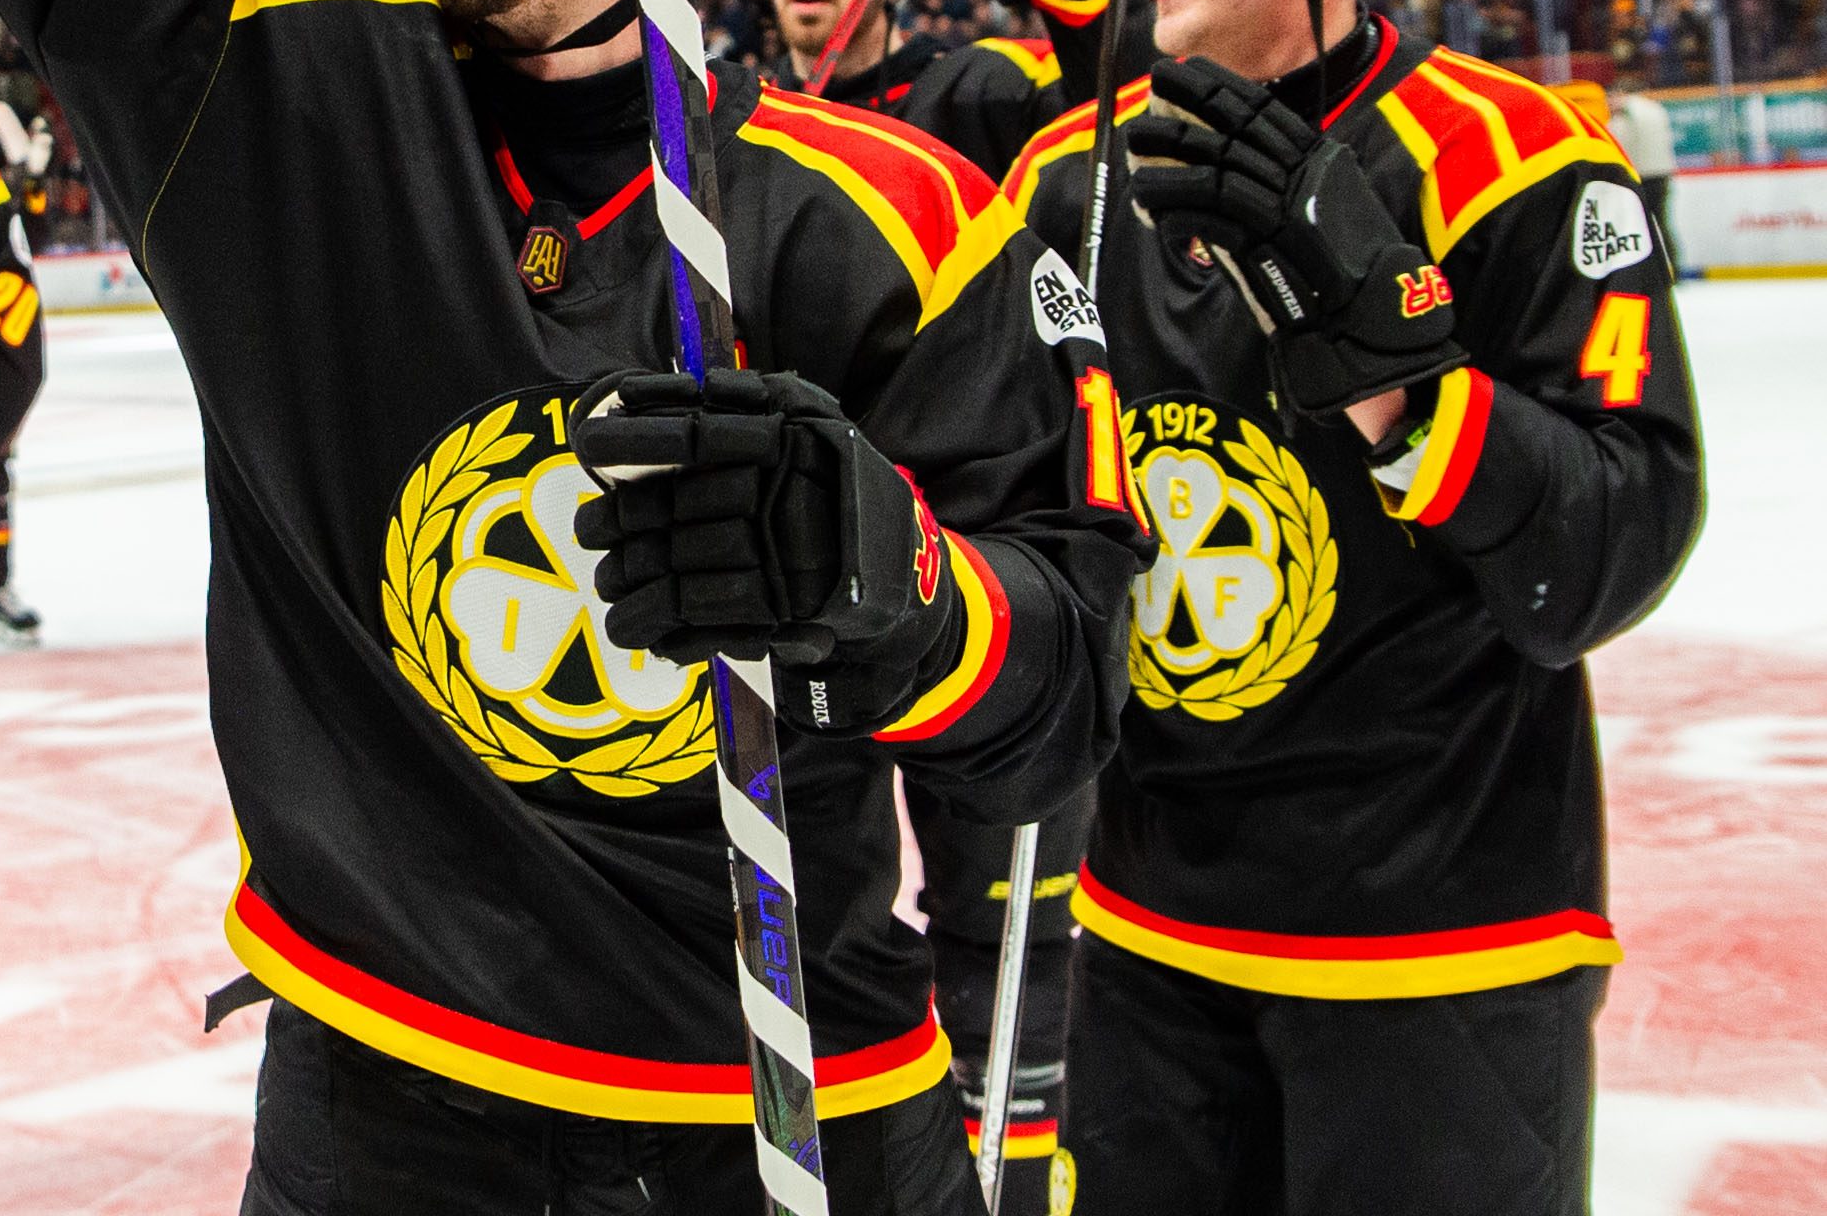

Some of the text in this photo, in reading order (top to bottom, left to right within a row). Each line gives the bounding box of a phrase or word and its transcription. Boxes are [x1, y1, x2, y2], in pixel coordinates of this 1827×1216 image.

[1582, 233, 1642, 266] START
[1034, 270, 1067, 304] EN
[1043, 286, 1095, 326] BRA
[1059, 306, 1102, 333] STA
[1580, 290, 1653, 408] 4
[1146, 402, 1218, 446] 1912
[1075, 365, 1150, 536] 1
